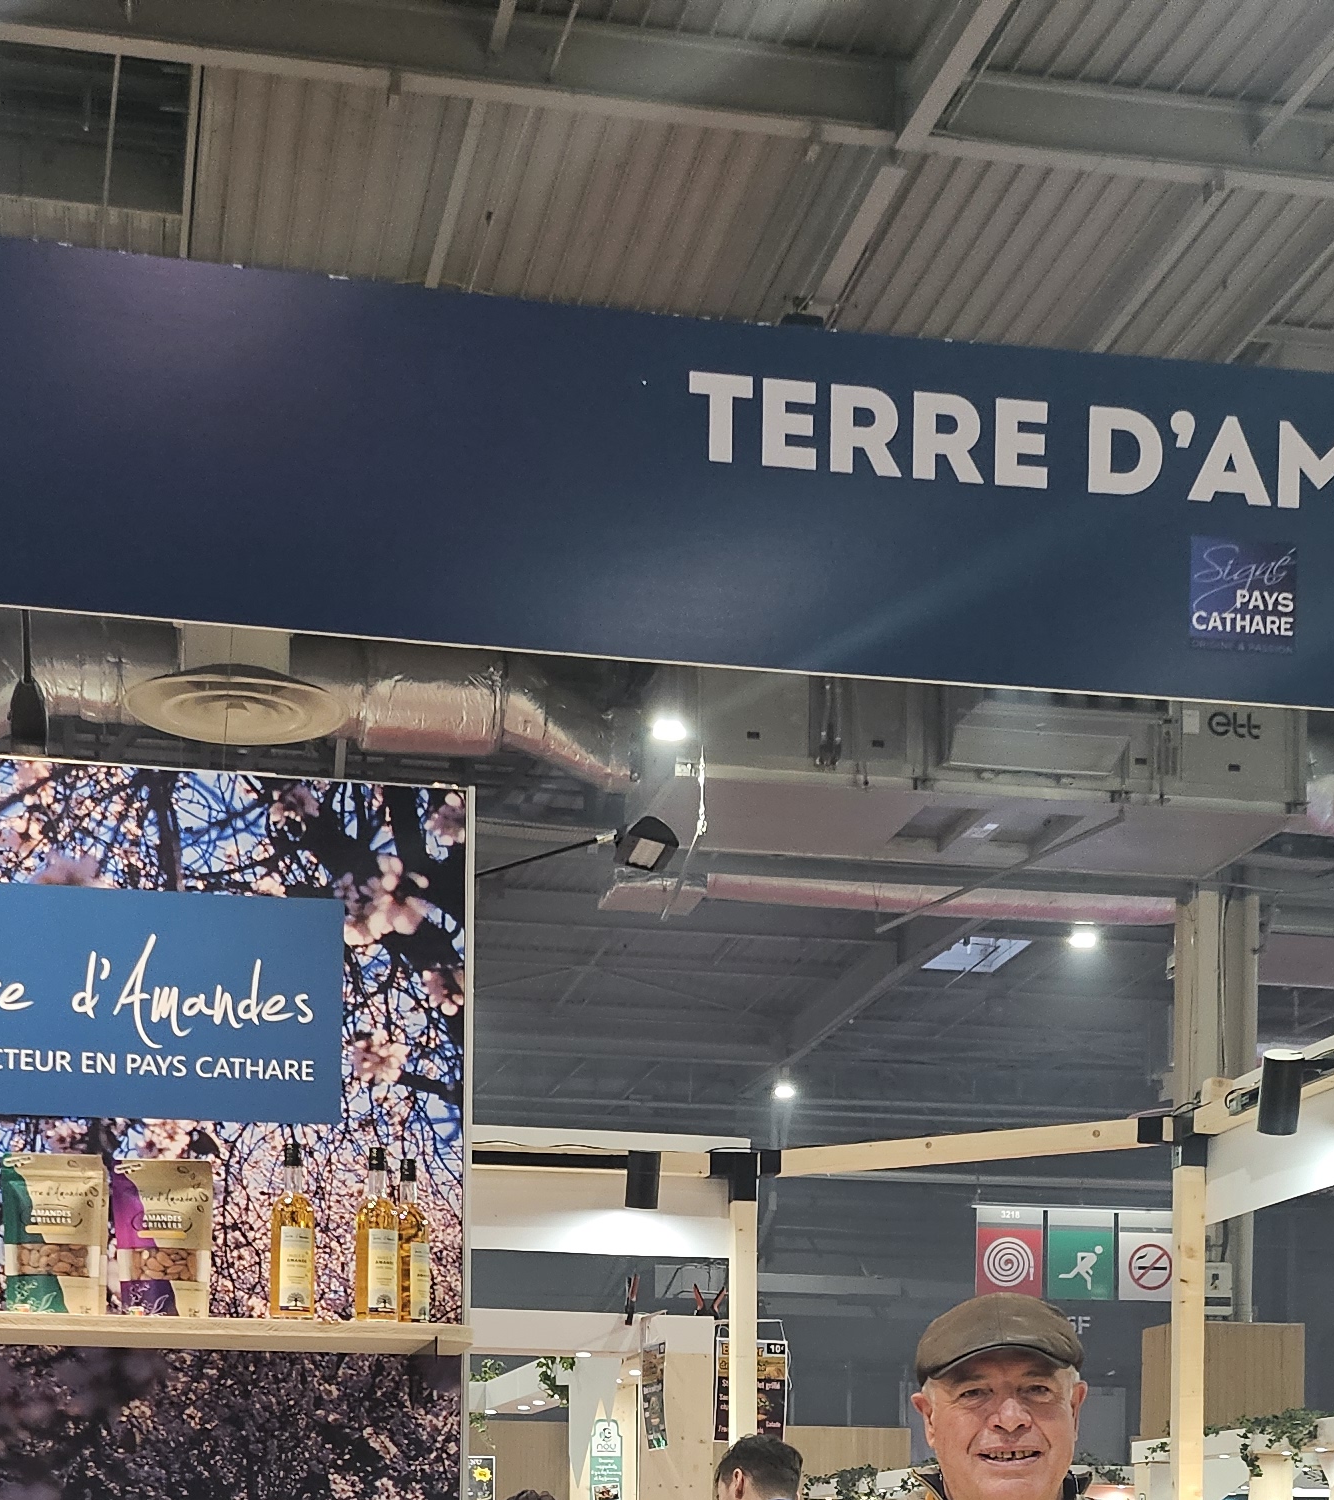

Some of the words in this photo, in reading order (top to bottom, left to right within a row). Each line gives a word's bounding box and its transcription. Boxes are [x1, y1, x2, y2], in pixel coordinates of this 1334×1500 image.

[689, 371, 1048, 490] TERRE
[1236, 589, 1294, 613] PAYS
[1192, 611, 1294, 637] CATHARE
[1208, 711, 1261, 740] ett
[72, 933, 315, 1048] d'Amandes
[81, 1049, 117, 1075] EN
[126, 1051, 188, 1079] PAYS
[195, 1054, 315, 1082] CATHARE
[30, 1208, 72, 1218] AMANDES
[142, 1213, 183, 1223] AMANDES
[1000, 1210, 1020, 1219] 3218
